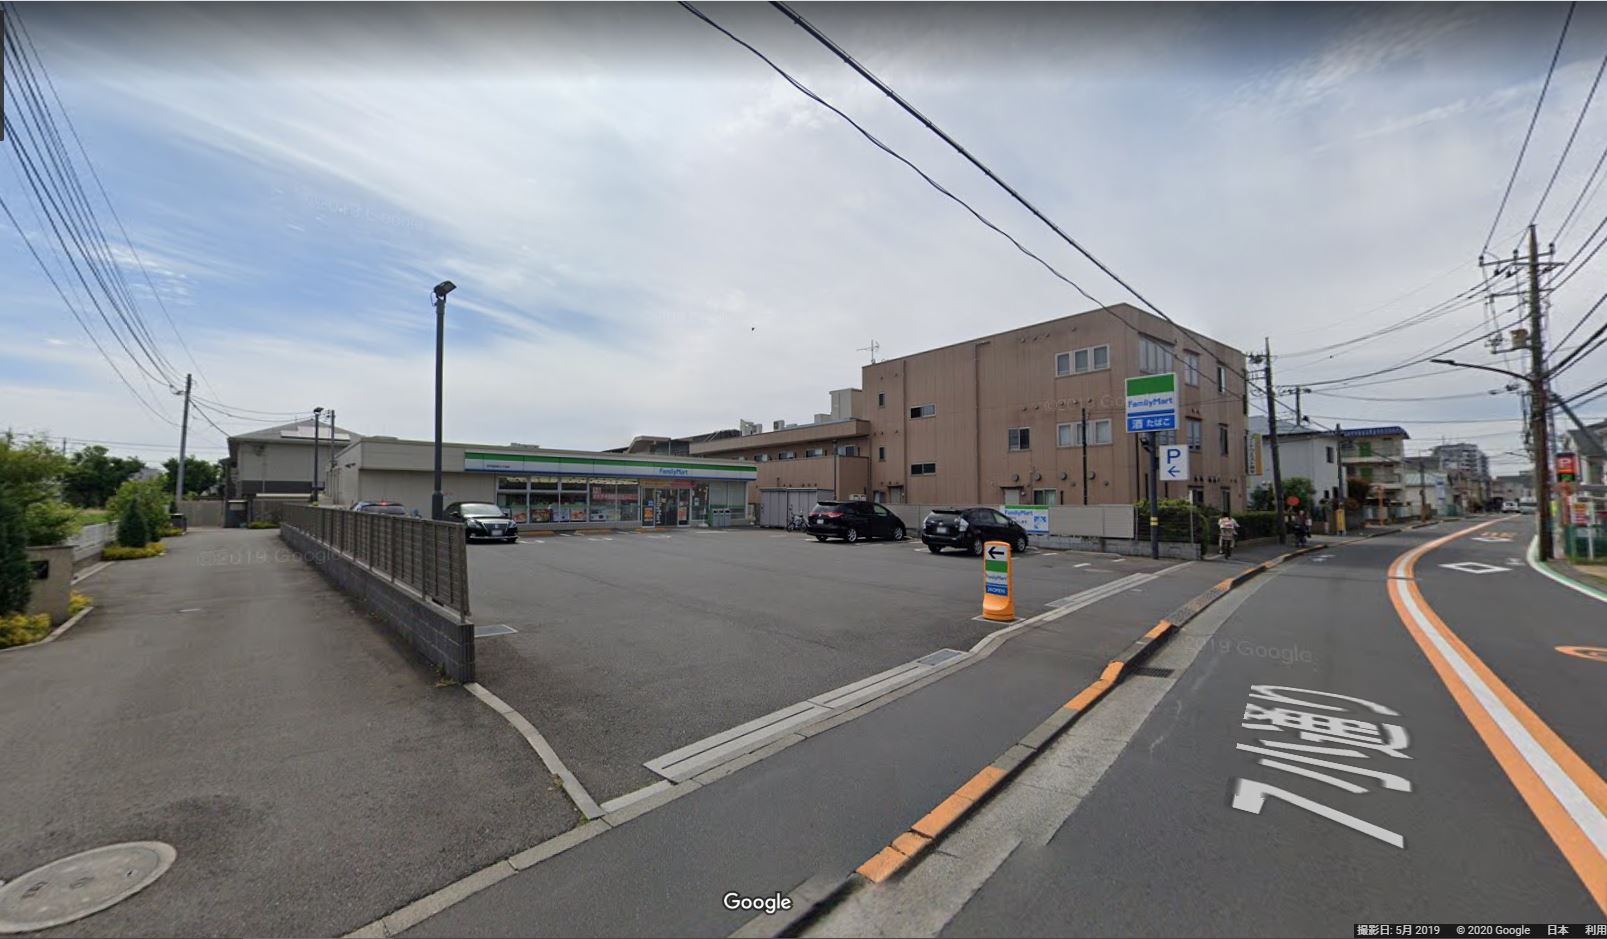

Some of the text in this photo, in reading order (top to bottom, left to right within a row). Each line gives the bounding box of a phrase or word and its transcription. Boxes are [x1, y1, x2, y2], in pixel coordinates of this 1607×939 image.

[1128, 397, 1173, 409] FamilyMart
[1132, 417, 1170, 429] 酒 たばこ
[1167, 448, 1181, 465] P
[659, 467, 689, 476] FamilyMart
